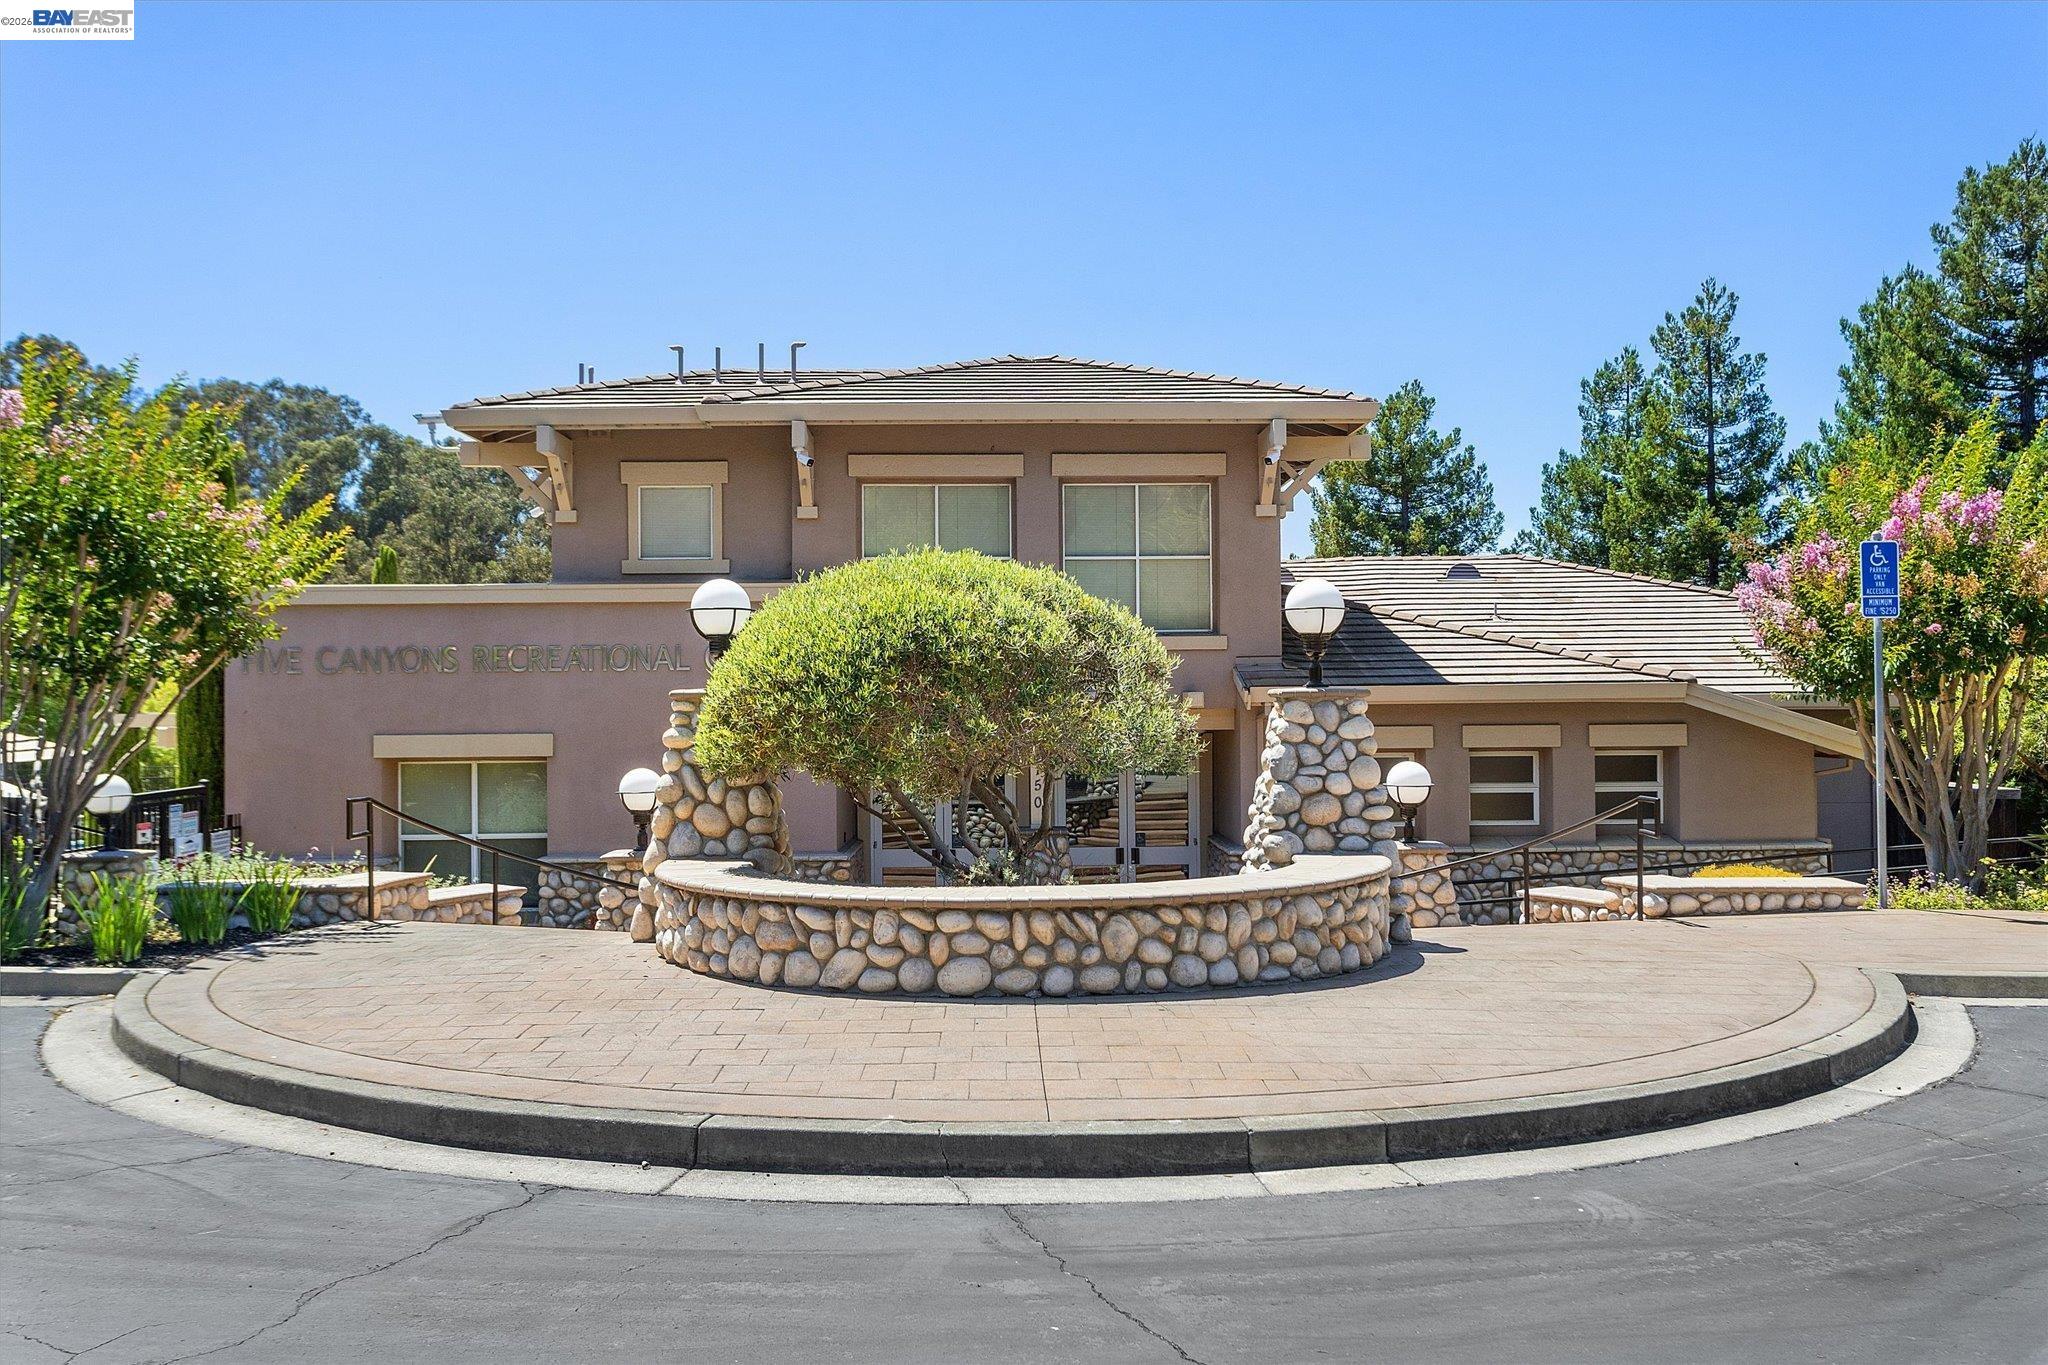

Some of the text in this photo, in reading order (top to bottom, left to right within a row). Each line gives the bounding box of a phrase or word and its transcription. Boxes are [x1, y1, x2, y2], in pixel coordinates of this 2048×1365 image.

[1880, 607, 1897, 615] $250
[315, 644, 460, 675] CANYONS
[472, 643, 691, 673] RECREATIONAL
[1034, 769, 1042, 808] 50
